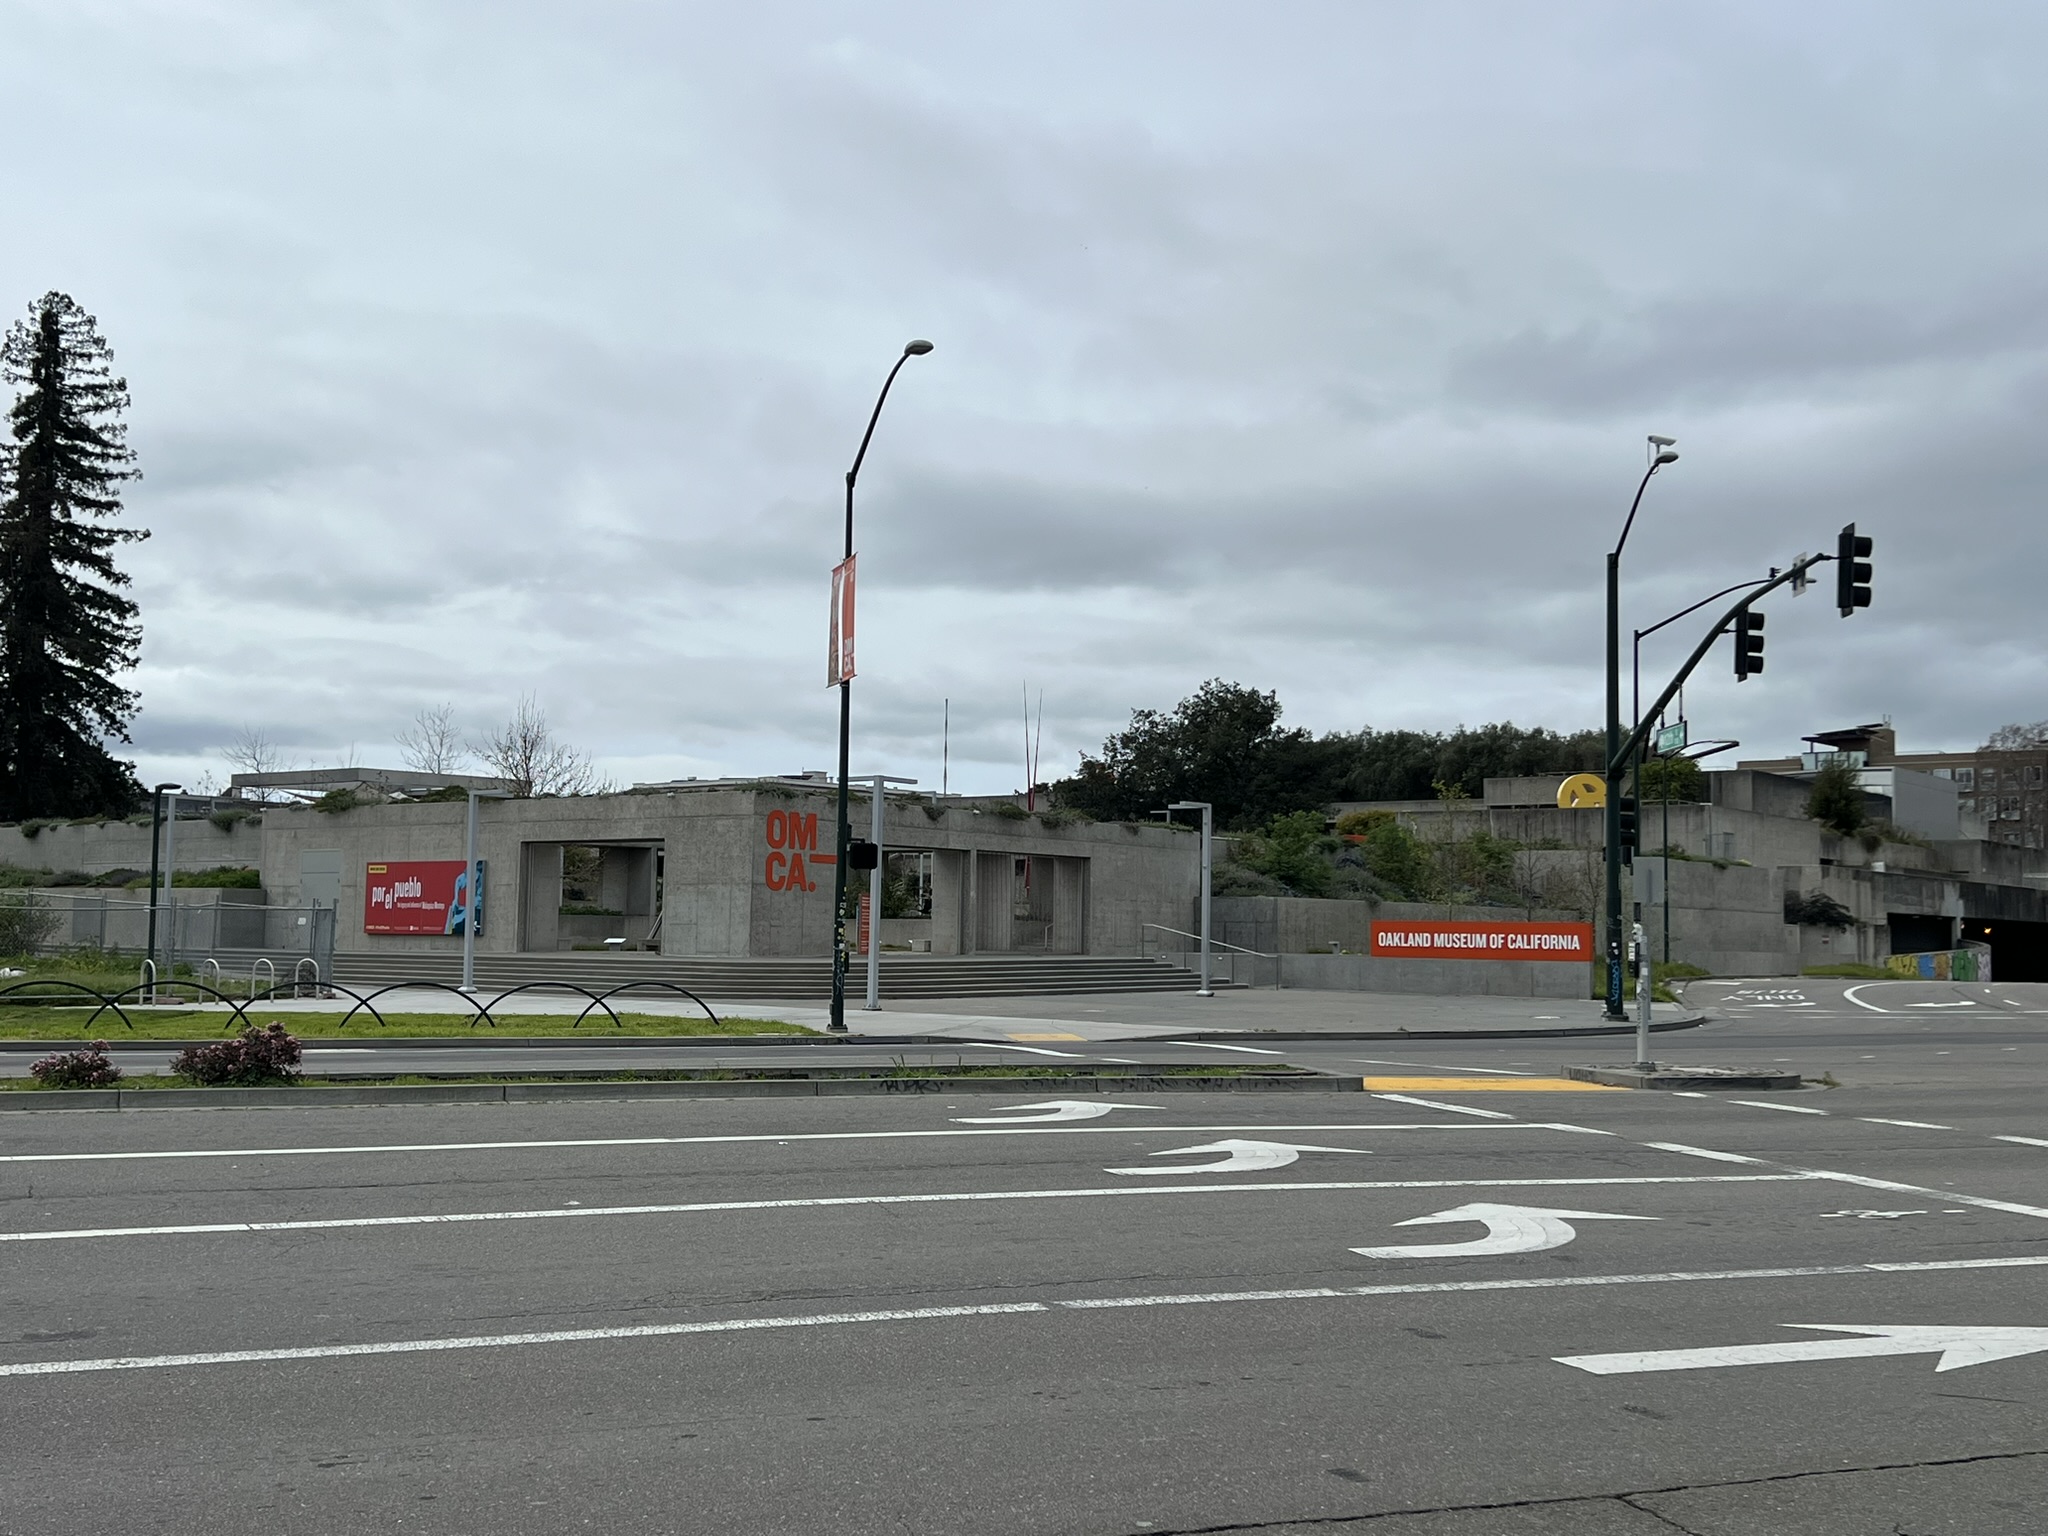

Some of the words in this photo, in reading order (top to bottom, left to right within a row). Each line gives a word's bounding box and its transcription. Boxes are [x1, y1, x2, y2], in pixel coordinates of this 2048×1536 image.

[766, 809, 817, 851] OM
[372, 886, 385, 906] por
[385, 888, 393, 909] el
[394, 877, 422, 902] pueblo
[1378, 931, 1431, 948] OAKLAND
[1434, 932, 1486, 949] MUSEUM
[1490, 933, 1505, 949] OF
[1508, 934, 1581, 950] CALIFORNIA
